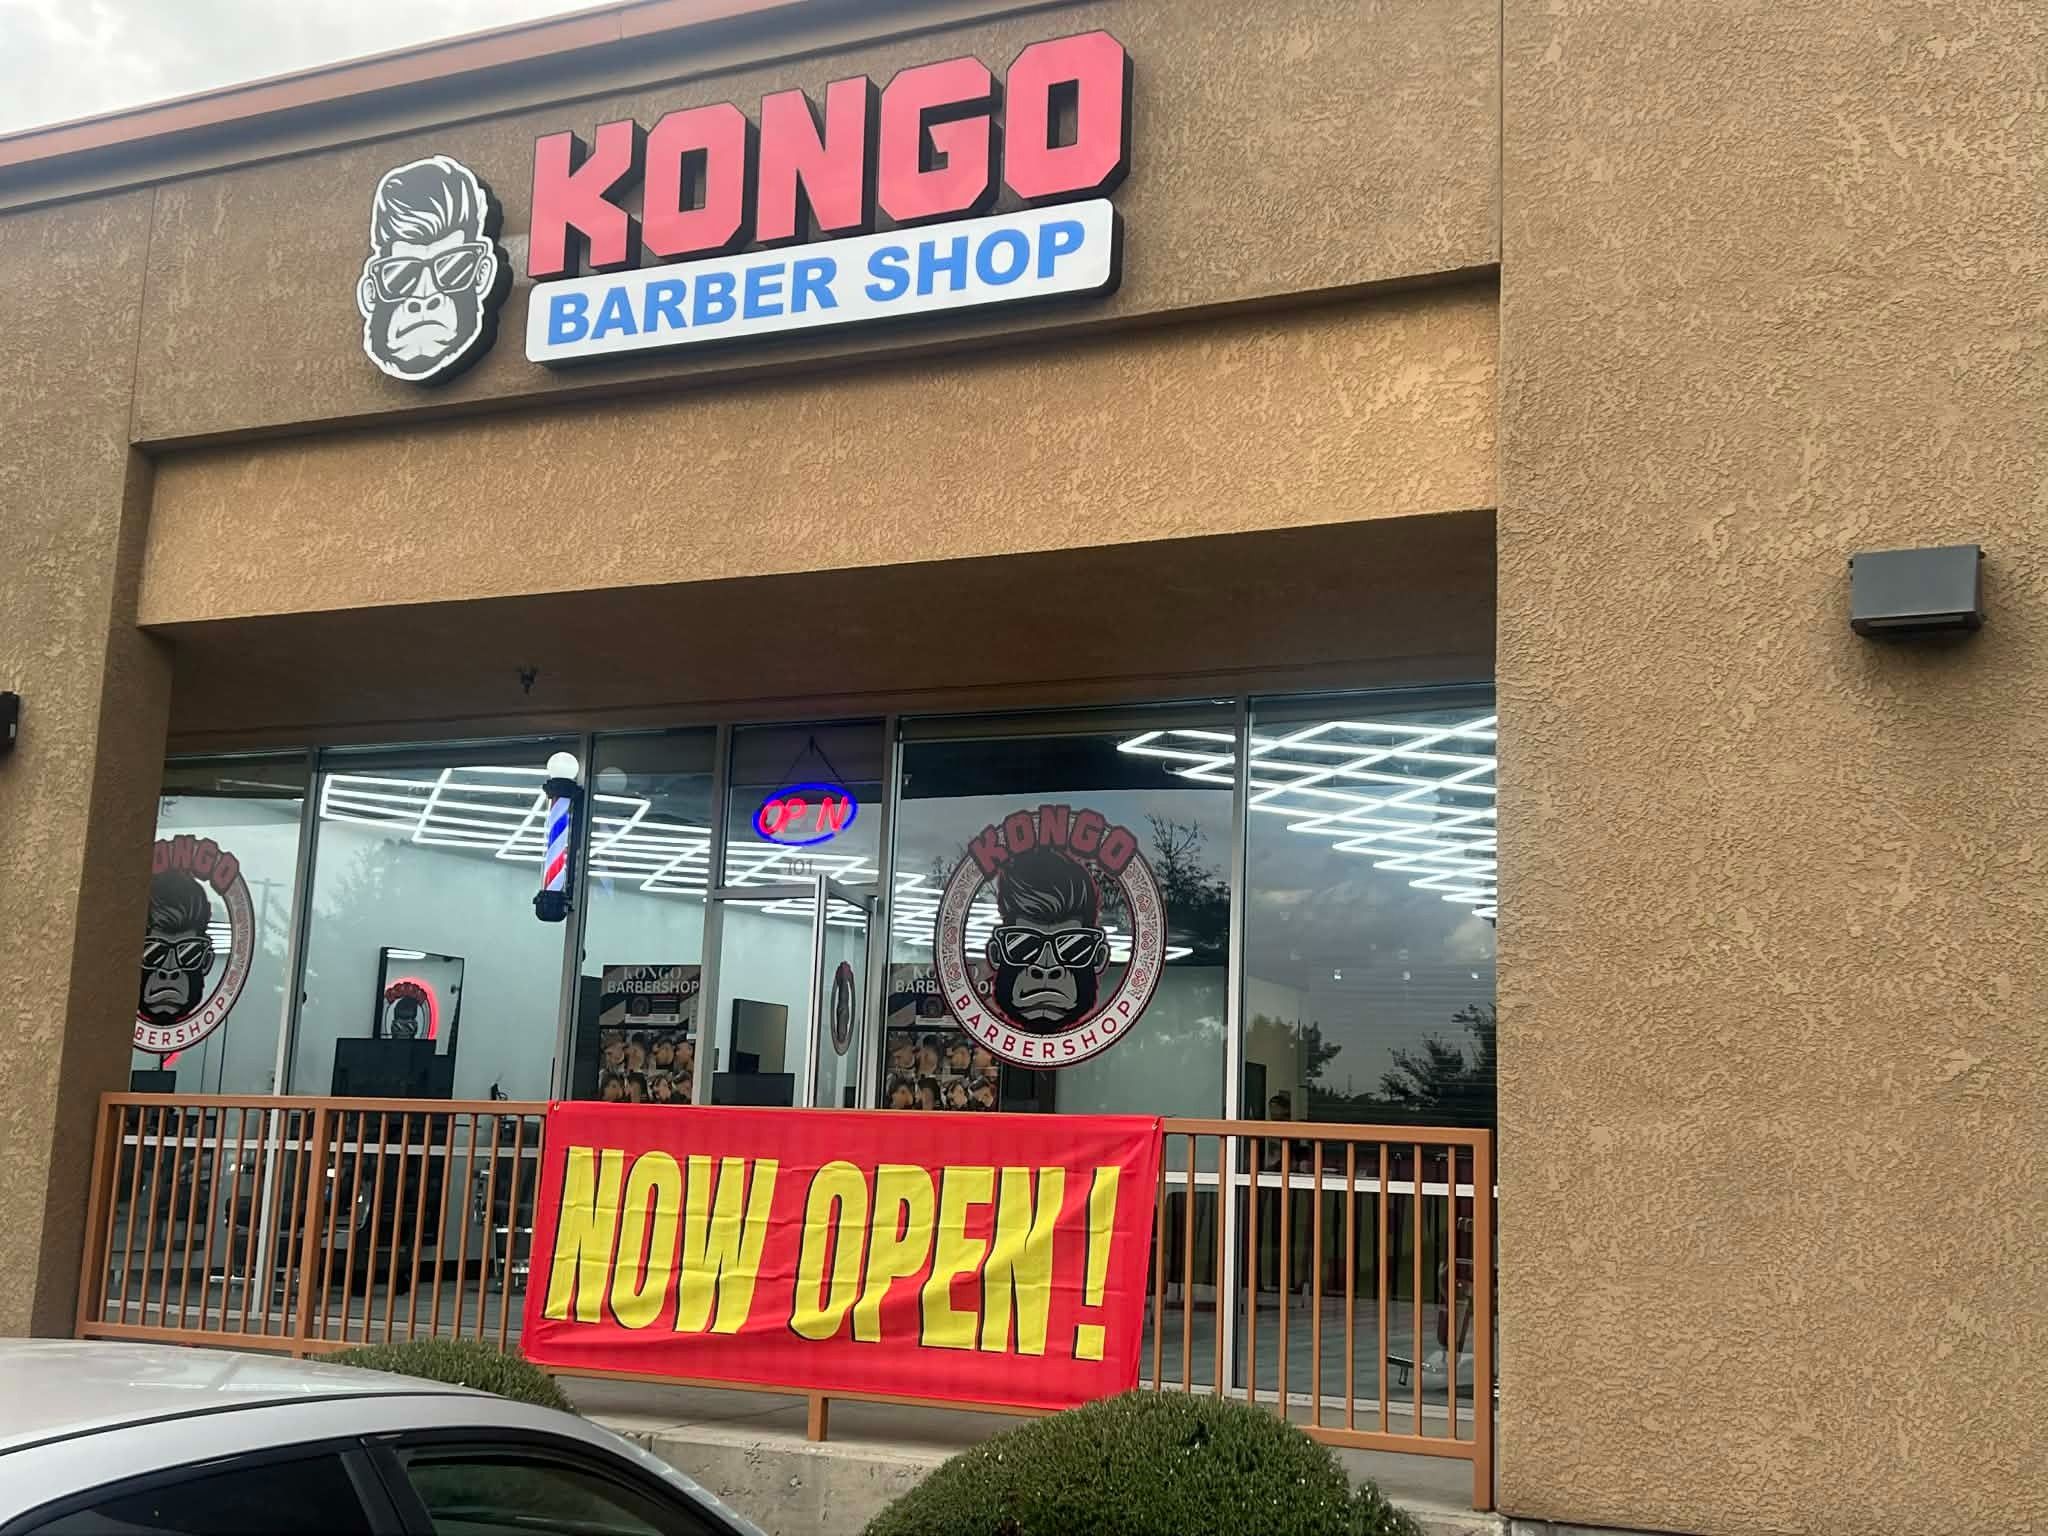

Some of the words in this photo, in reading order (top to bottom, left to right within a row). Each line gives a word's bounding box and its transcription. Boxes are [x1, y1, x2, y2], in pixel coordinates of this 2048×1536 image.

[527, 29, 1128, 278] KONGO
[547, 261, 837, 345] BARBER
[865, 219, 1086, 303] SHOP
[759, 796, 848, 835] OPN
[968, 804, 1137, 879] KONGO
[152, 834, 240, 896] ONGO
[608, 980, 699, 994] BARBERSHOP
[135, 996, 225, 1045] BERSHOP
[956, 994, 1131, 1059] BARBERSHOP
[542, 1145, 780, 1335] NOW
